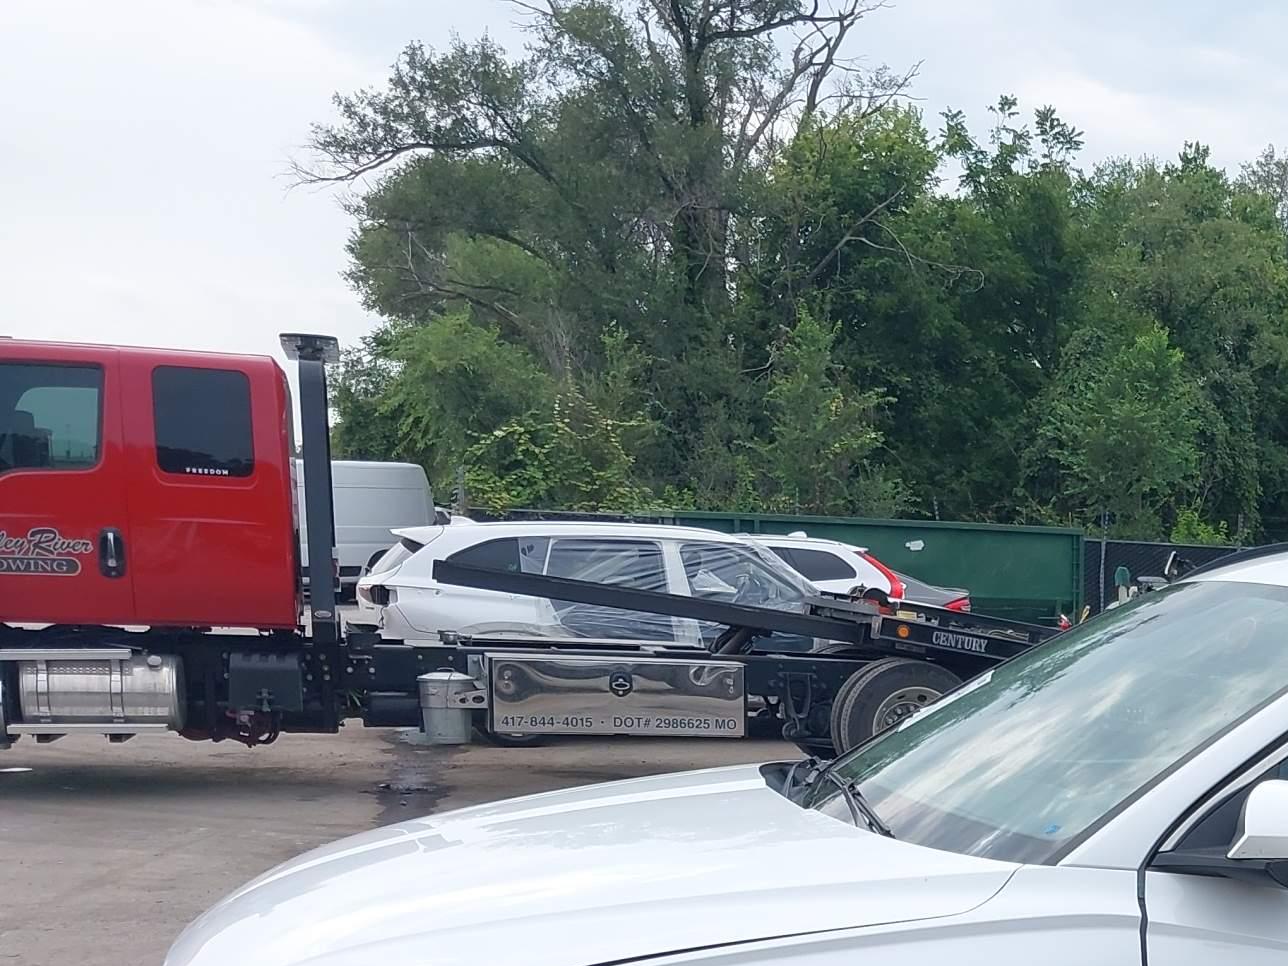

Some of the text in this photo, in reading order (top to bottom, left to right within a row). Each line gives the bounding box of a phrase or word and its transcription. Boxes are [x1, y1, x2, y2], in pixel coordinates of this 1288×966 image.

[185, 467, 229, 476] FREEDOM
[28, 527, 94, 557] River
[932, 631, 988, 653] CENTURY
[501, 716, 593, 728] 417-844-4015
[613, 716, 651, 729] DOT#
[655, 717, 711, 730] 2986625
[715, 719, 737, 730] MO
